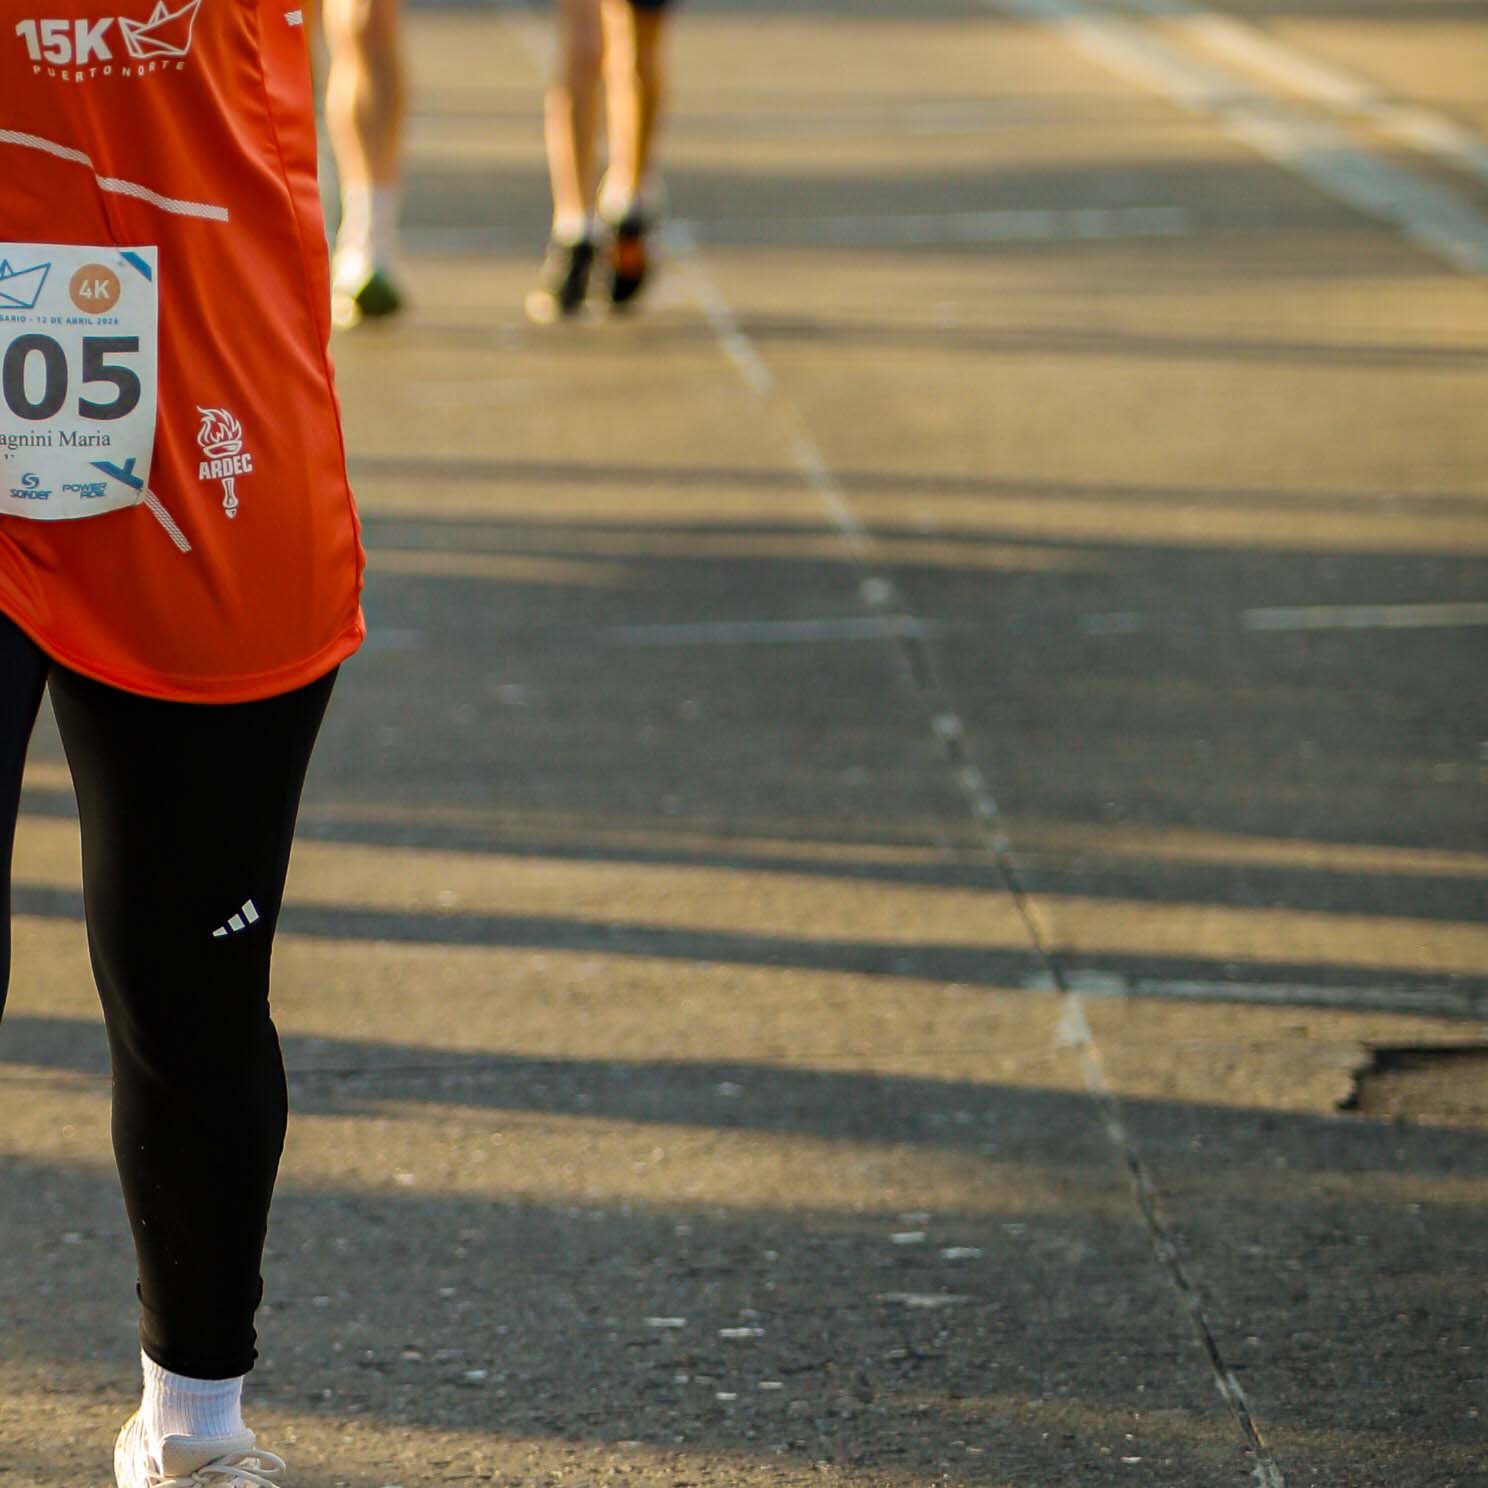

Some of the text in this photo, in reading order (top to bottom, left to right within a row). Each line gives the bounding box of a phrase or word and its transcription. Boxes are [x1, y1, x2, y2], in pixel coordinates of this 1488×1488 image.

[15, 17, 115, 65] 15K
[32, 60, 186, 83] PUERTO NORTE
[79, 279, 111, 300] 4K
[65, 317, 93, 325] ABRIL
[58, 430, 112, 448] Maria
[198, 453, 253, 480] ARDEC
